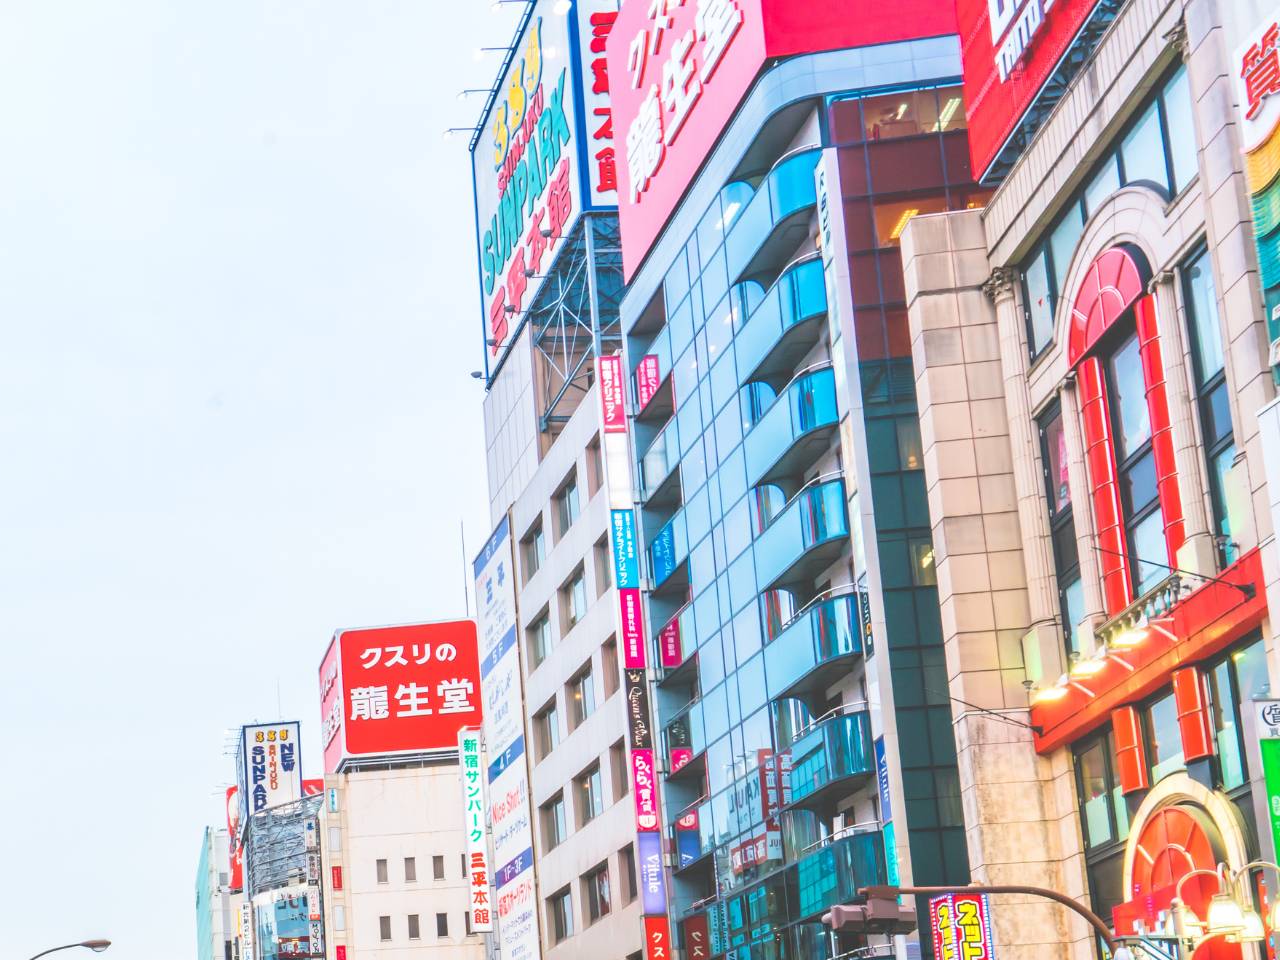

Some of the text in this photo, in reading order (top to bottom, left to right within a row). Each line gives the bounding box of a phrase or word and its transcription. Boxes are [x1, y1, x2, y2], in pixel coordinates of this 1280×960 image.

[484, 66, 570, 296] SUNPARK
[360, 643, 457, 669] クスリの
[350, 678, 475, 721] 龍生堂
[280, 743, 295, 772] NEW
[464, 739, 490, 924] 新宿サンパーク 三平本館
[492, 801, 506, 826] Nice
[647, 853, 661, 893] Vitule
